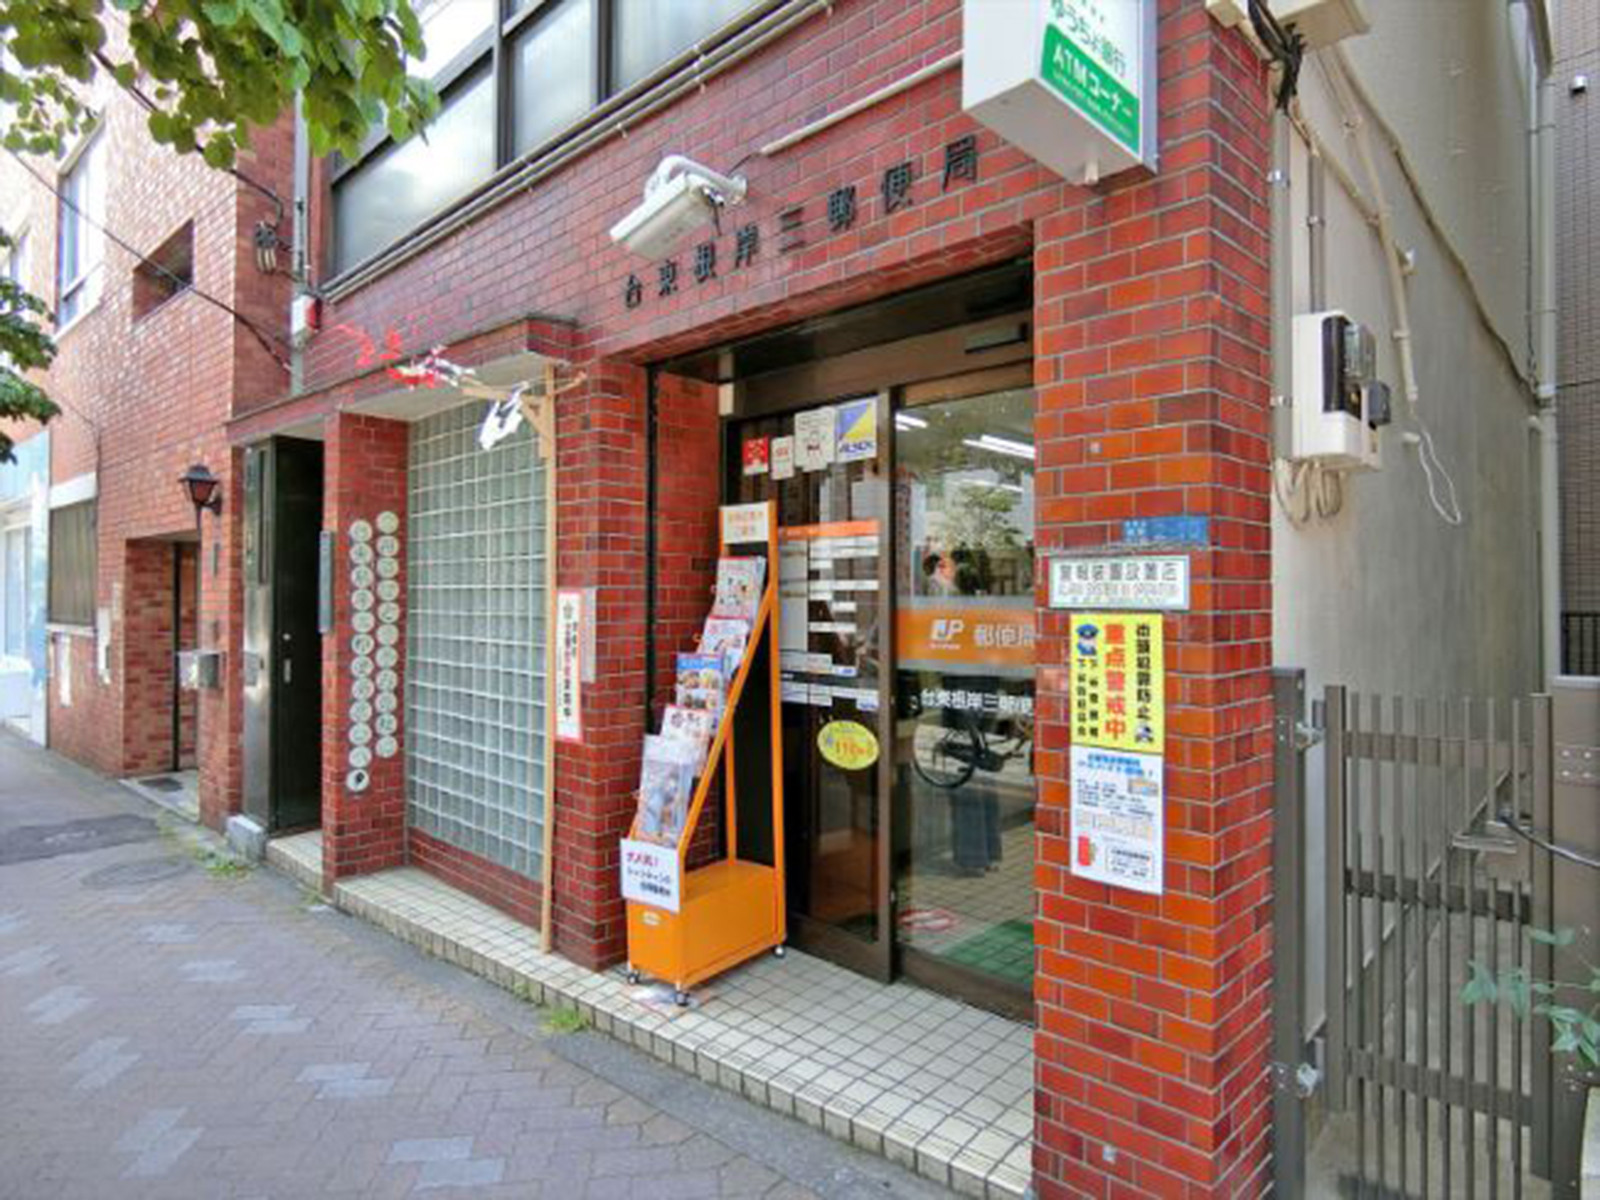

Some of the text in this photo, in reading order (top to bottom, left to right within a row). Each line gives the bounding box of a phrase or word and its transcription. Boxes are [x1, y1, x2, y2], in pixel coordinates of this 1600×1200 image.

[1053, 44, 1133, 117] ATMコーナー
[625, 134, 977, 309] 台東根岸三郵便局
